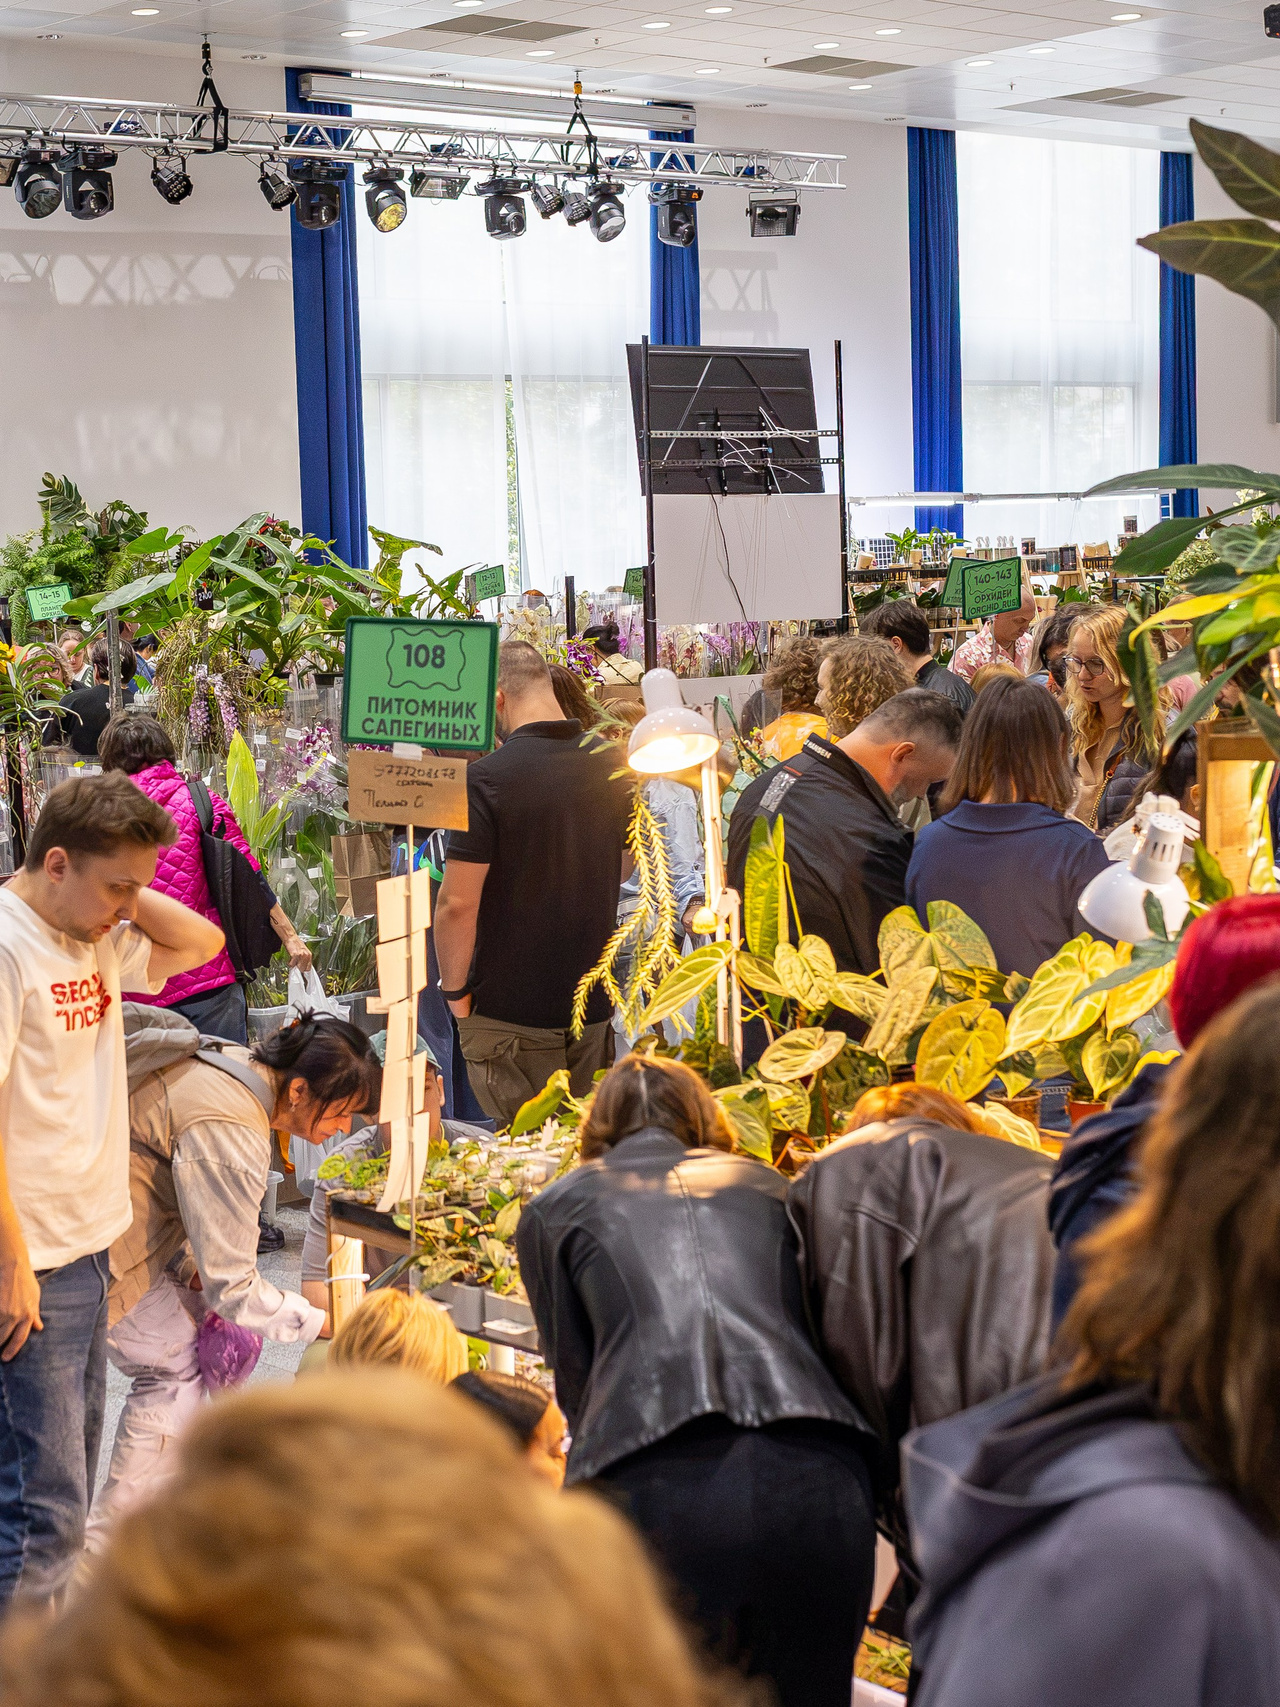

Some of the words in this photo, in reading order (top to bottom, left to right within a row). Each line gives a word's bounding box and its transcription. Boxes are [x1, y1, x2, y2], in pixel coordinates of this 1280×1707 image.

[974, 568, 1012, 586] 140-143
[39, 590, 61, 600] 14-15
[967, 602, 1000, 617] (ORCHID
[1002, 597, 1019, 608] RUS)
[403, 643, 446, 669] 108
[367, 696, 478, 720] ПИТОМНИК
[361, 717, 481, 742] САПЕГИНЫХ
